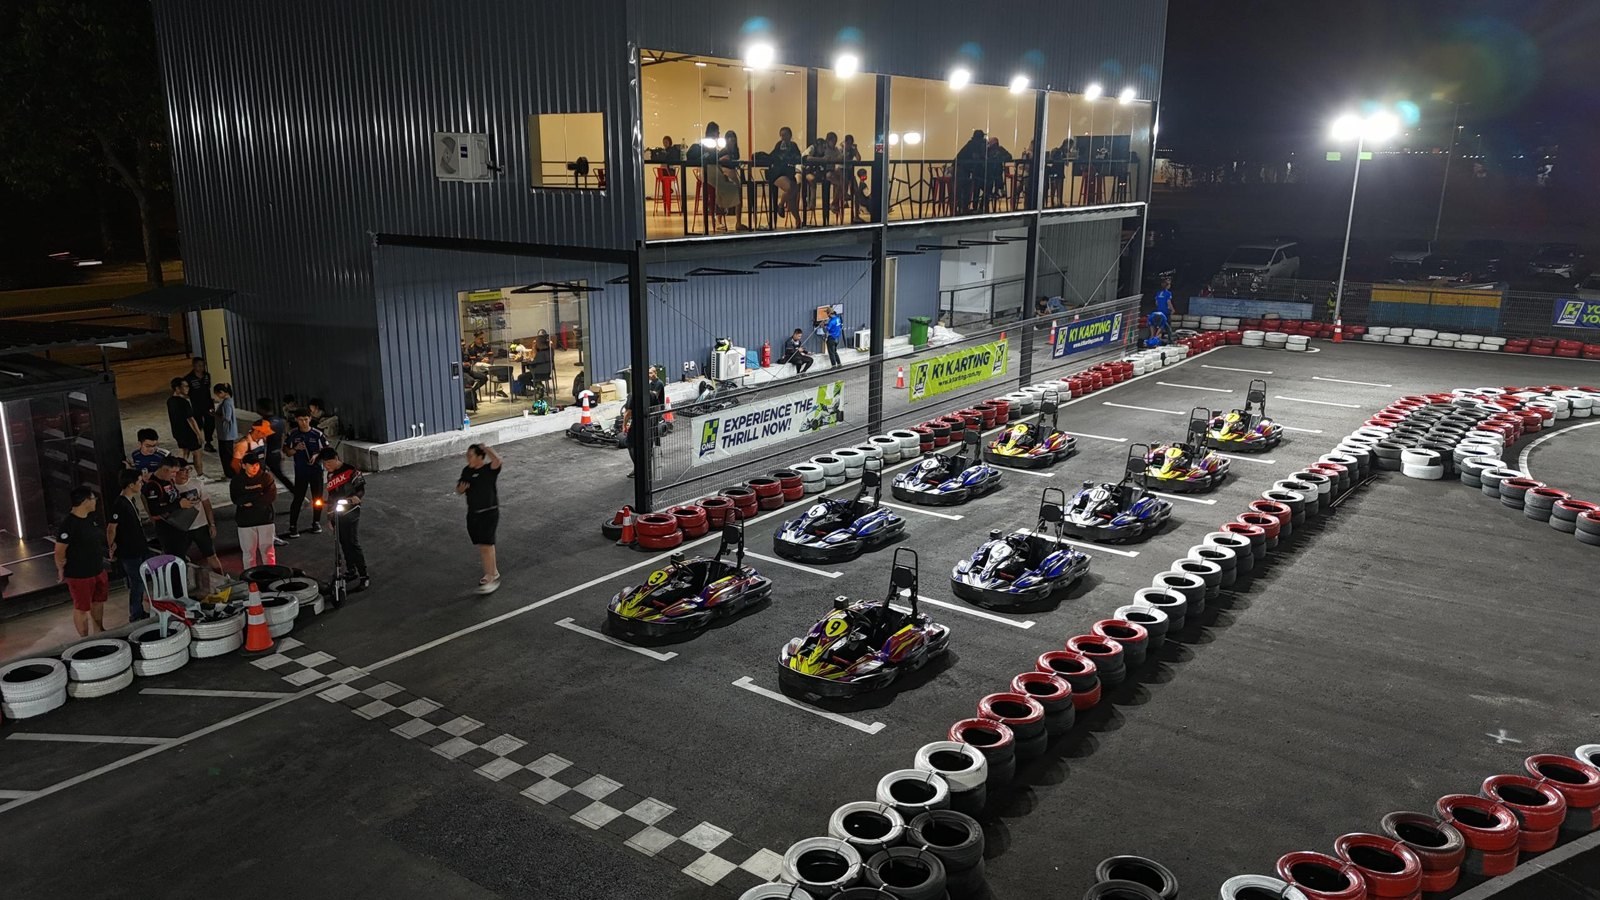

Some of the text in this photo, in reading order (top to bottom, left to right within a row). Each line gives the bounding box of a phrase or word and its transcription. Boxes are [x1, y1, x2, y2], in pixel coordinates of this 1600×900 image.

[1582, 314, 1600, 324] YO
[1068, 319, 1112, 343] K1 KARTING
[931, 351, 991, 380] K1 KARTING
[723, 398, 813, 433] EXPERIENCE THE
[722, 418, 791, 448] THRILL NOW!
[702, 442, 715, 450] ONE
[924, 460, 933, 469] 8
[327, 474, 346, 488] OTAX
[1093, 490, 1106, 499] 10
[810, 506, 820, 516] 6
[650, 572, 664, 584] 3
[828, 620, 841, 635] 9
